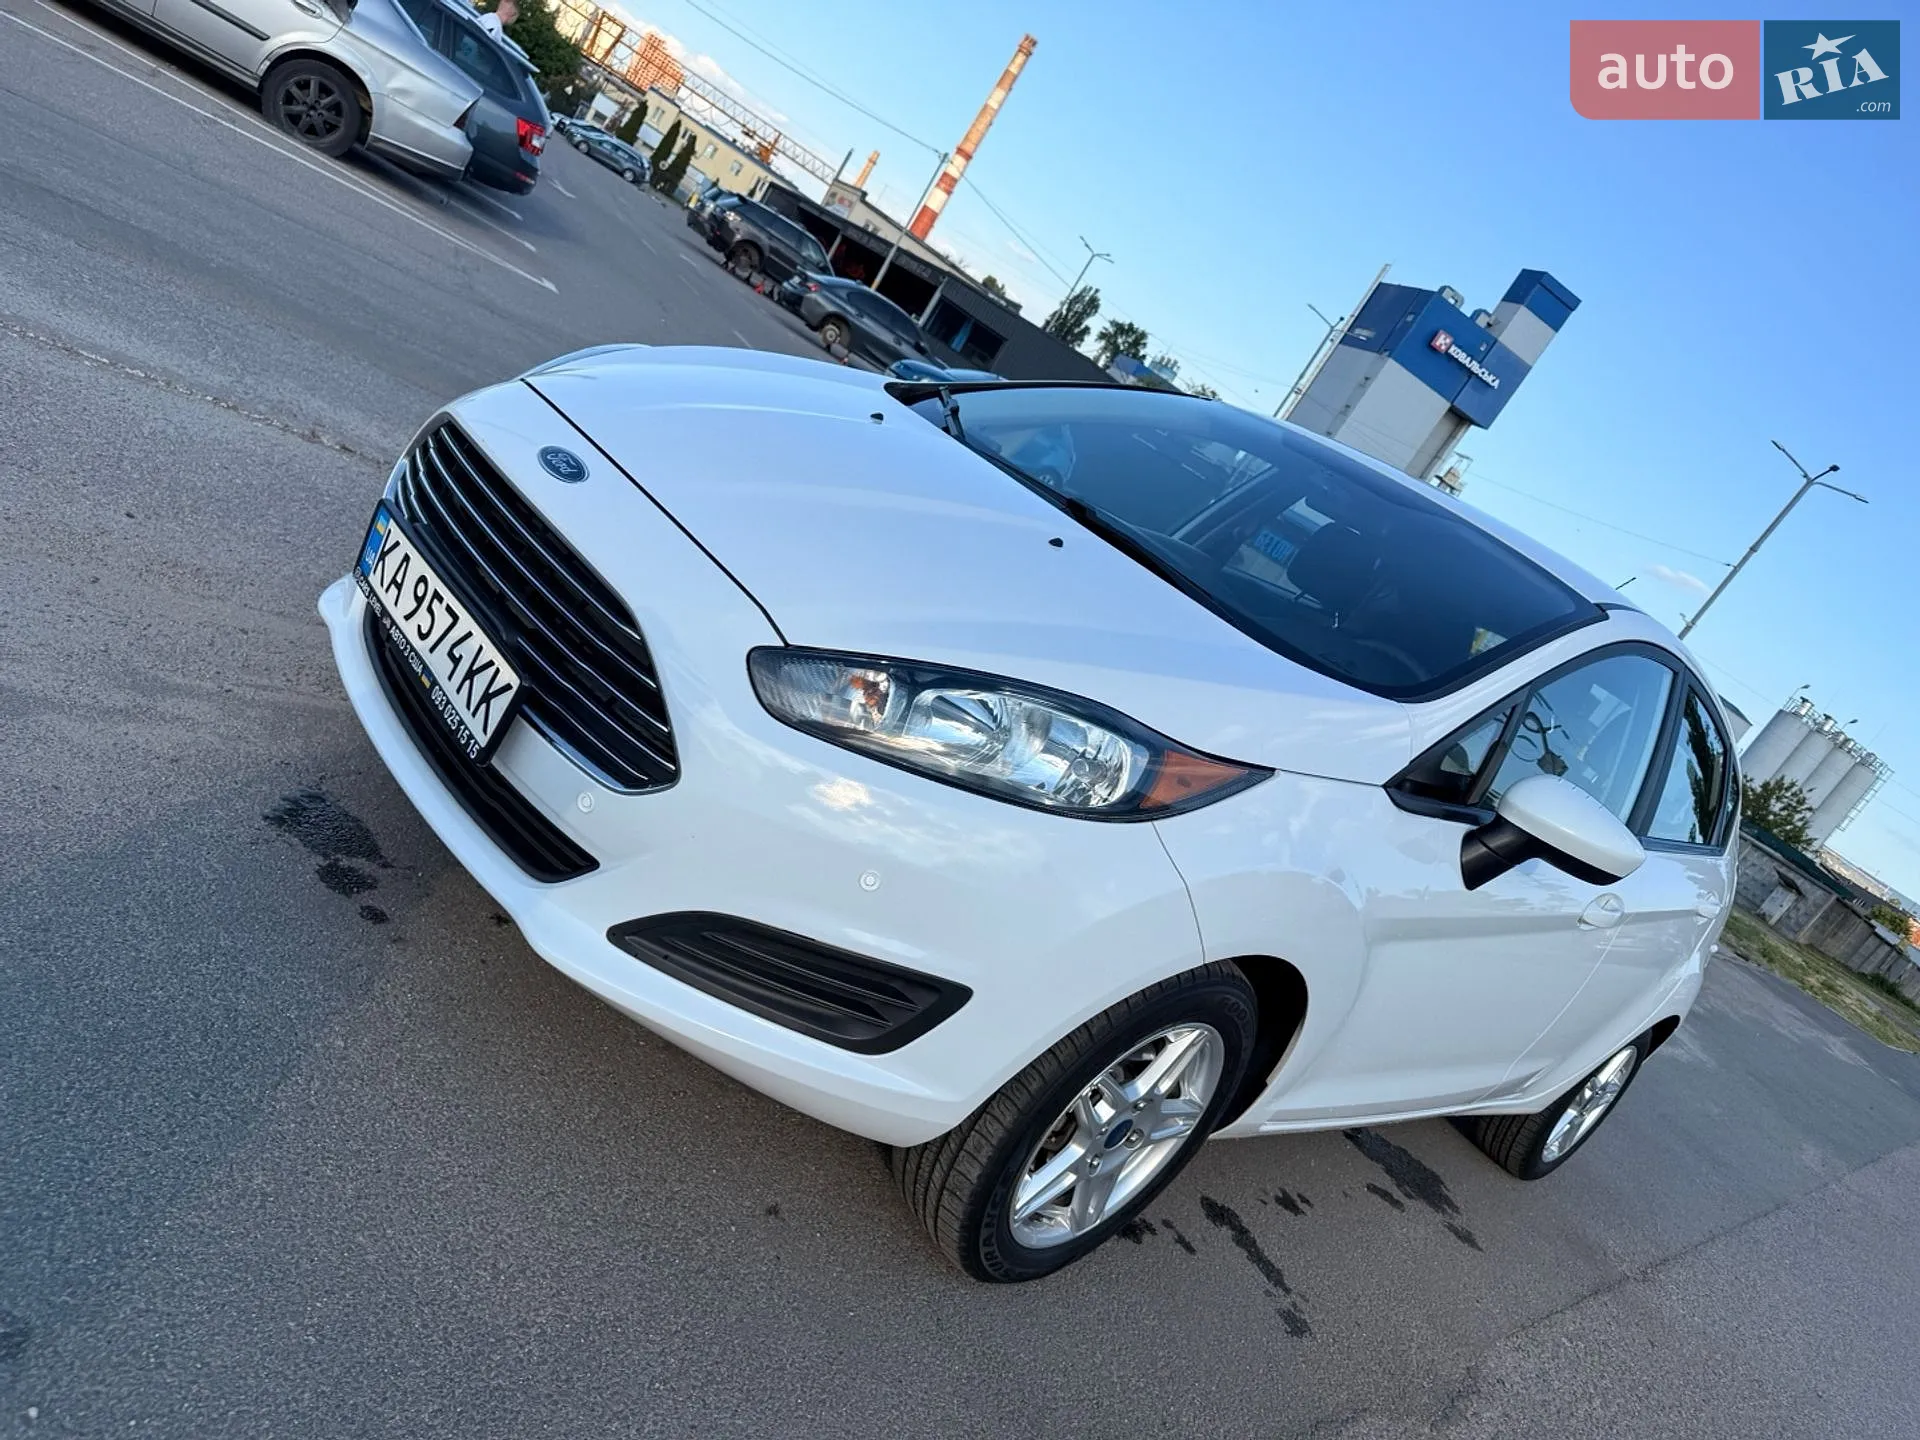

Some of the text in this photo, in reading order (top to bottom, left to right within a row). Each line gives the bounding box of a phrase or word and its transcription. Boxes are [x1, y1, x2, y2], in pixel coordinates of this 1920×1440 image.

[1447, 344, 1500, 389] КОВАЛЬСЬКА
[430, 685, 480, 759] 093 025 15 15
